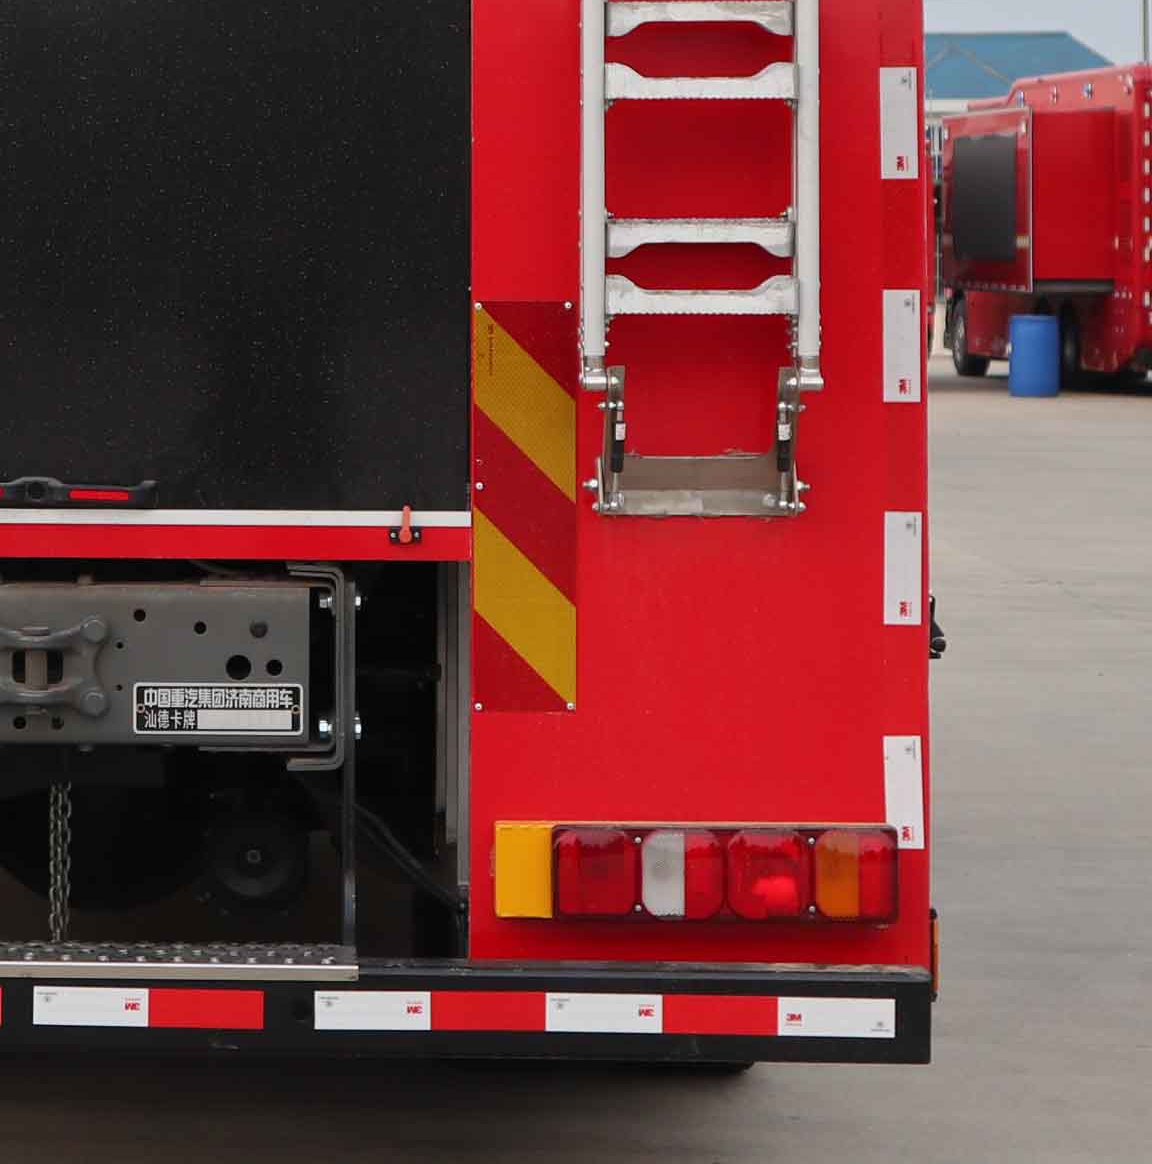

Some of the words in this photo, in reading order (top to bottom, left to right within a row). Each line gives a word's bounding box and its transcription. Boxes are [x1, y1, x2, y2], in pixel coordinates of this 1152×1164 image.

[144, 688, 293, 709] 中国重汽集团济南商用车
[144, 710, 196, 729] 汕德卡牌
